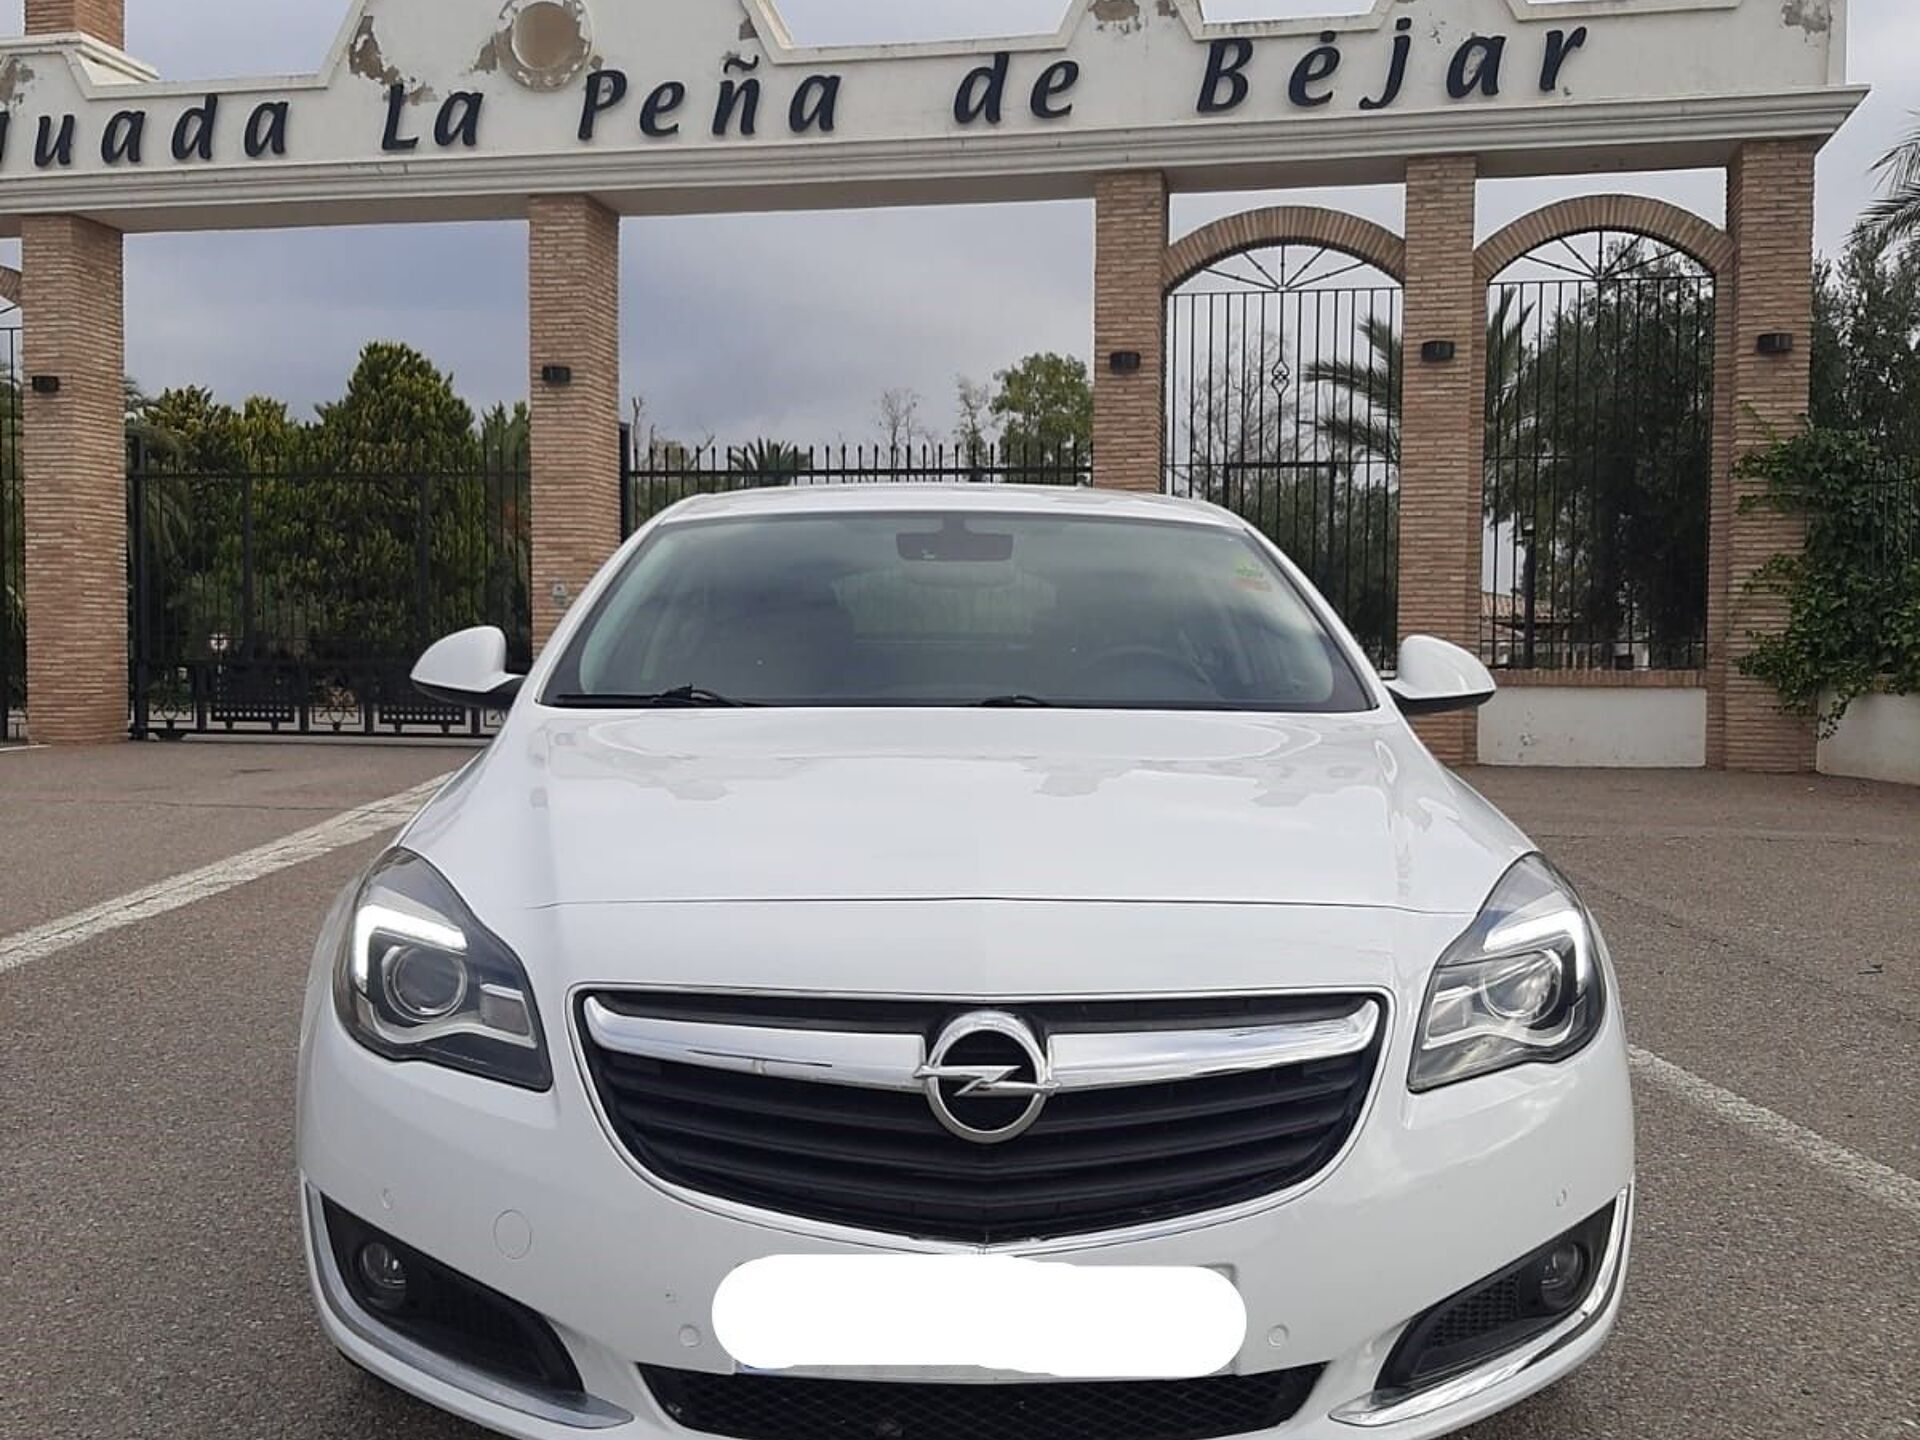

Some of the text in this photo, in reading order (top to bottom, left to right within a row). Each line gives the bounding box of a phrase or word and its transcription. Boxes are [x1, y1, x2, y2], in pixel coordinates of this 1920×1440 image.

[0, 96, 289, 168] uada
[381, 82, 484, 151] La
[578, 55, 841, 141] Peña
[953, 51, 1080, 126] de
